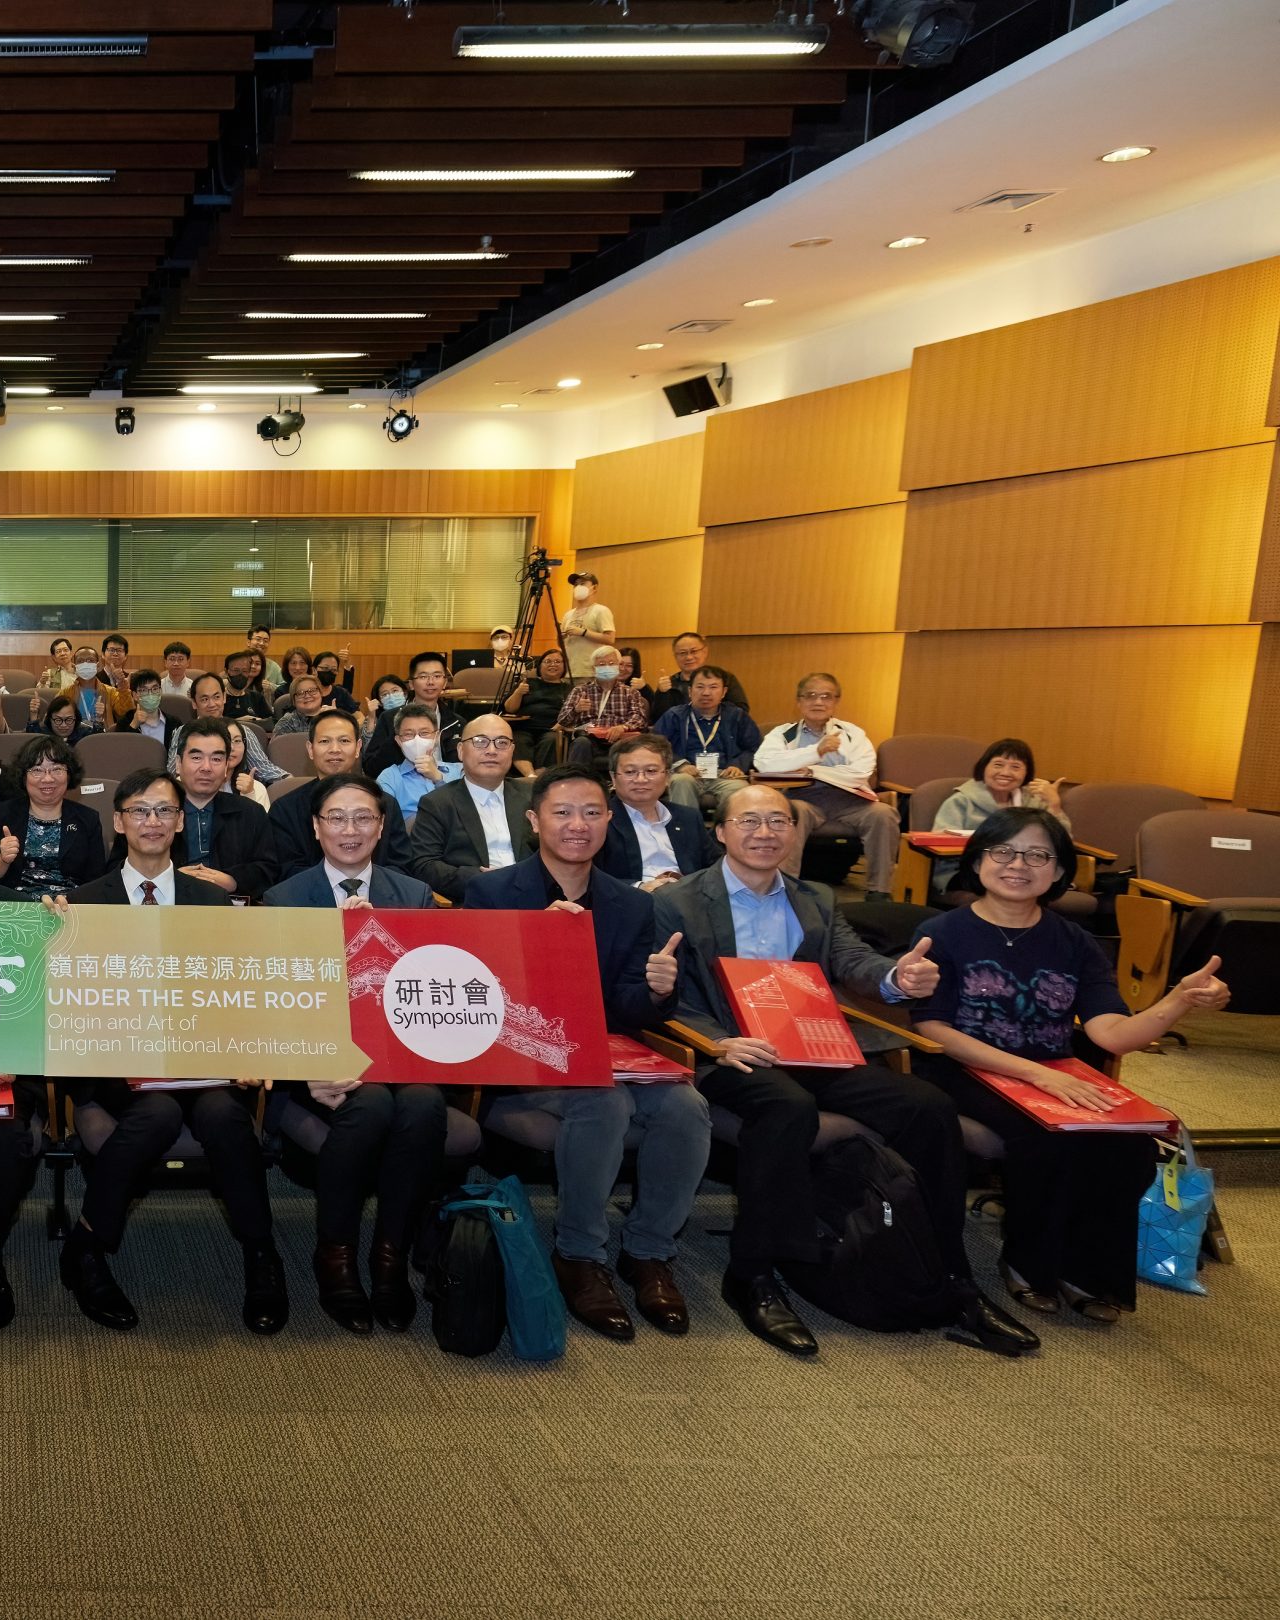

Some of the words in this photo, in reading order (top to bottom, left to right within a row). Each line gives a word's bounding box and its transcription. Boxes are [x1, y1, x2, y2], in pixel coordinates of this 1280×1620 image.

[48, 953, 342, 983] 嶺南傳統建築源流與藝術
[47, 988, 131, 1007] UNDER
[136, 989, 184, 1007] THE
[191, 989, 258, 1009] SAME
[264, 991, 328, 1010] ROOF
[394, 977, 491, 1006] 研討會
[47, 1013, 102, 1034] Origin
[107, 1014, 142, 1031] and
[146, 1015, 174, 1031] Art
[178, 1015, 199, 1031] of
[393, 1007, 498, 1029] Symposium
[47, 1035, 122, 1056] Lingnan
[126, 1036, 223, 1055] Traditional
[226, 1037, 339, 1056] Architecture
